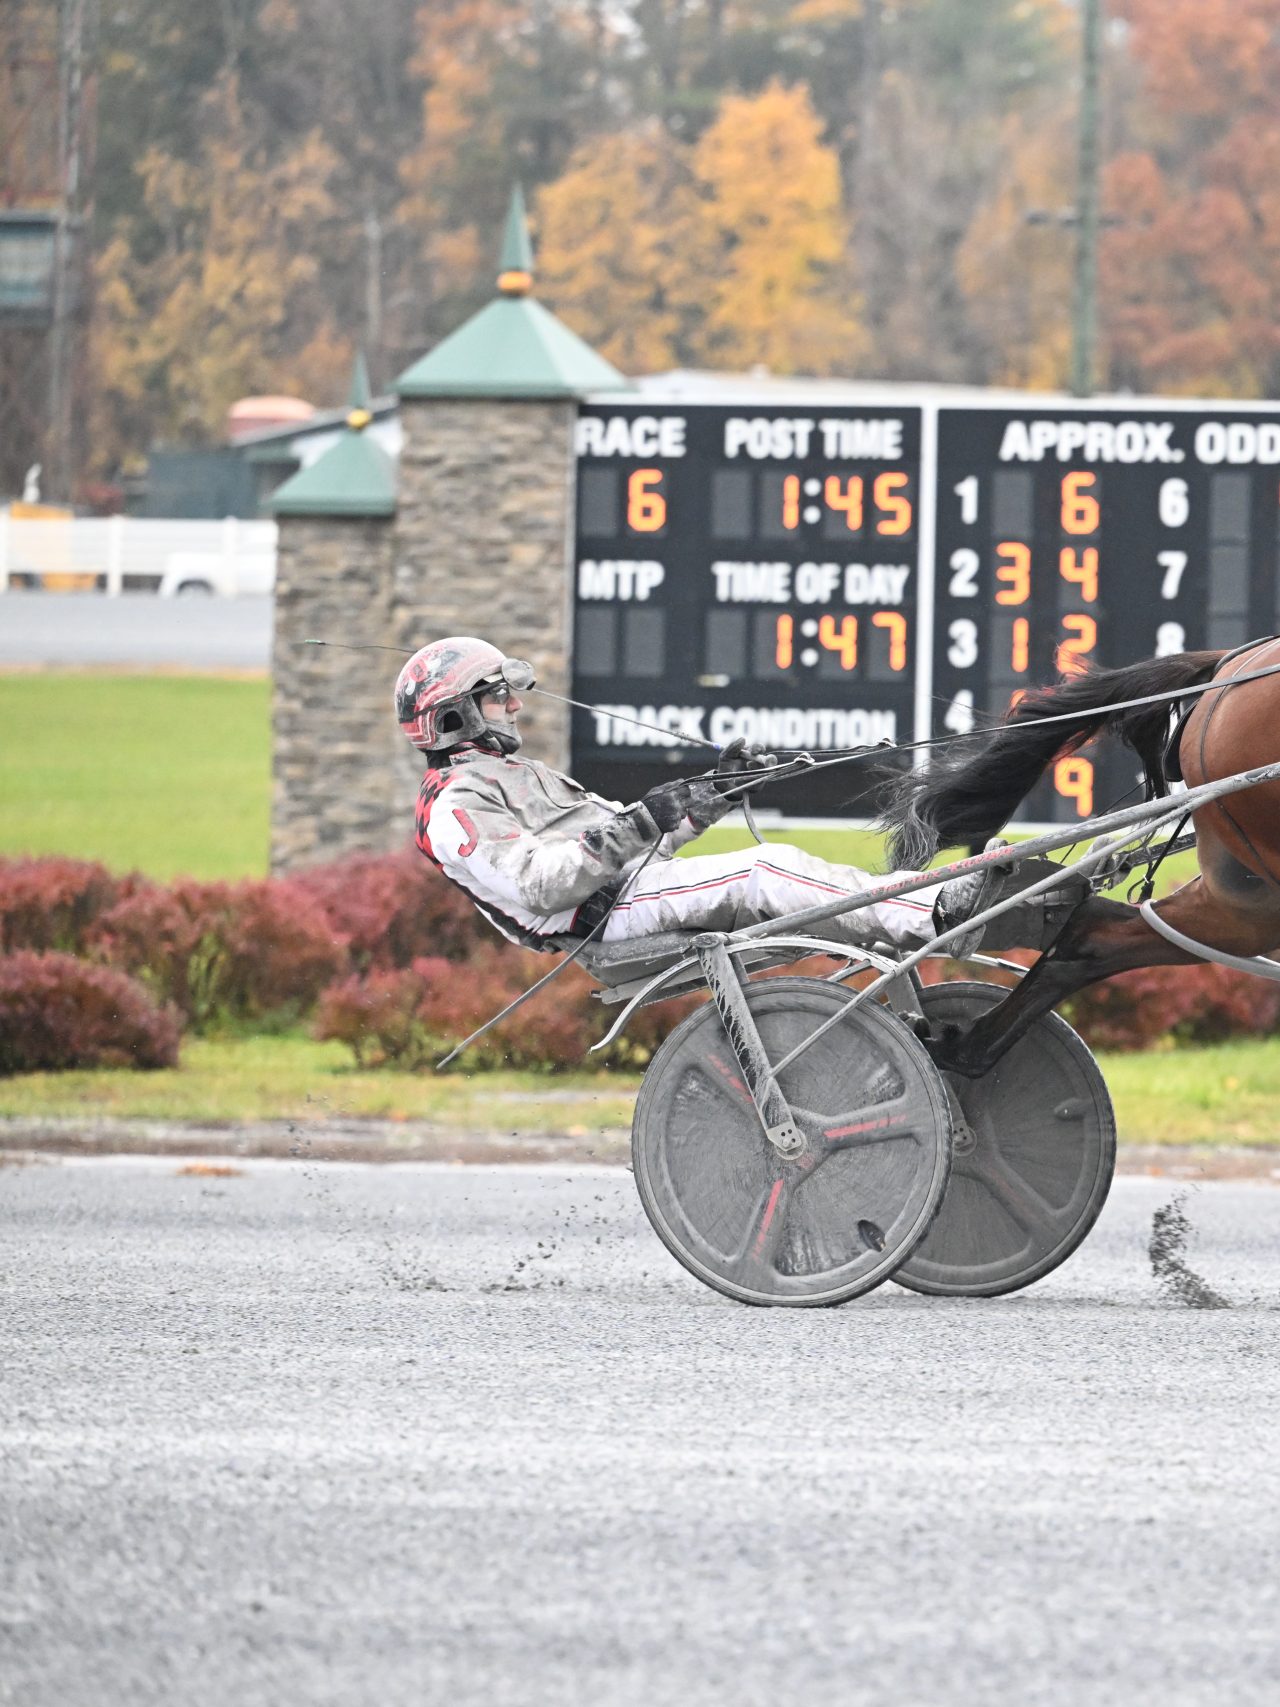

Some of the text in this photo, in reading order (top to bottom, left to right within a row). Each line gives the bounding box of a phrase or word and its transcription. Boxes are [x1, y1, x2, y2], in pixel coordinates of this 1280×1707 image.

[573, 416, 686, 458] RACE
[724, 417, 904, 460] POST TIME
[999, 420, 1185, 463] APPROX.
[627, 468, 666, 532] 6
[783, 471, 912, 535] 1:45
[954, 475, 979, 524] 1
[1061, 471, 1100, 535] 6
[1159, 477, 1190, 527] 6
[578, 560, 665, 601] MTP
[711, 561, 909, 606] TIME OF DAY
[949, 547, 980, 598] 2
[995, 541, 1099, 605] 34
[1157, 550, 1188, 599] 7
[776, 611, 907, 672] 1:47
[948, 618, 979, 668] 3
[591, 704, 897, 750] TRACK CONDITION
[944, 688, 976, 735] 4
[1054, 755, 1094, 818] 9
